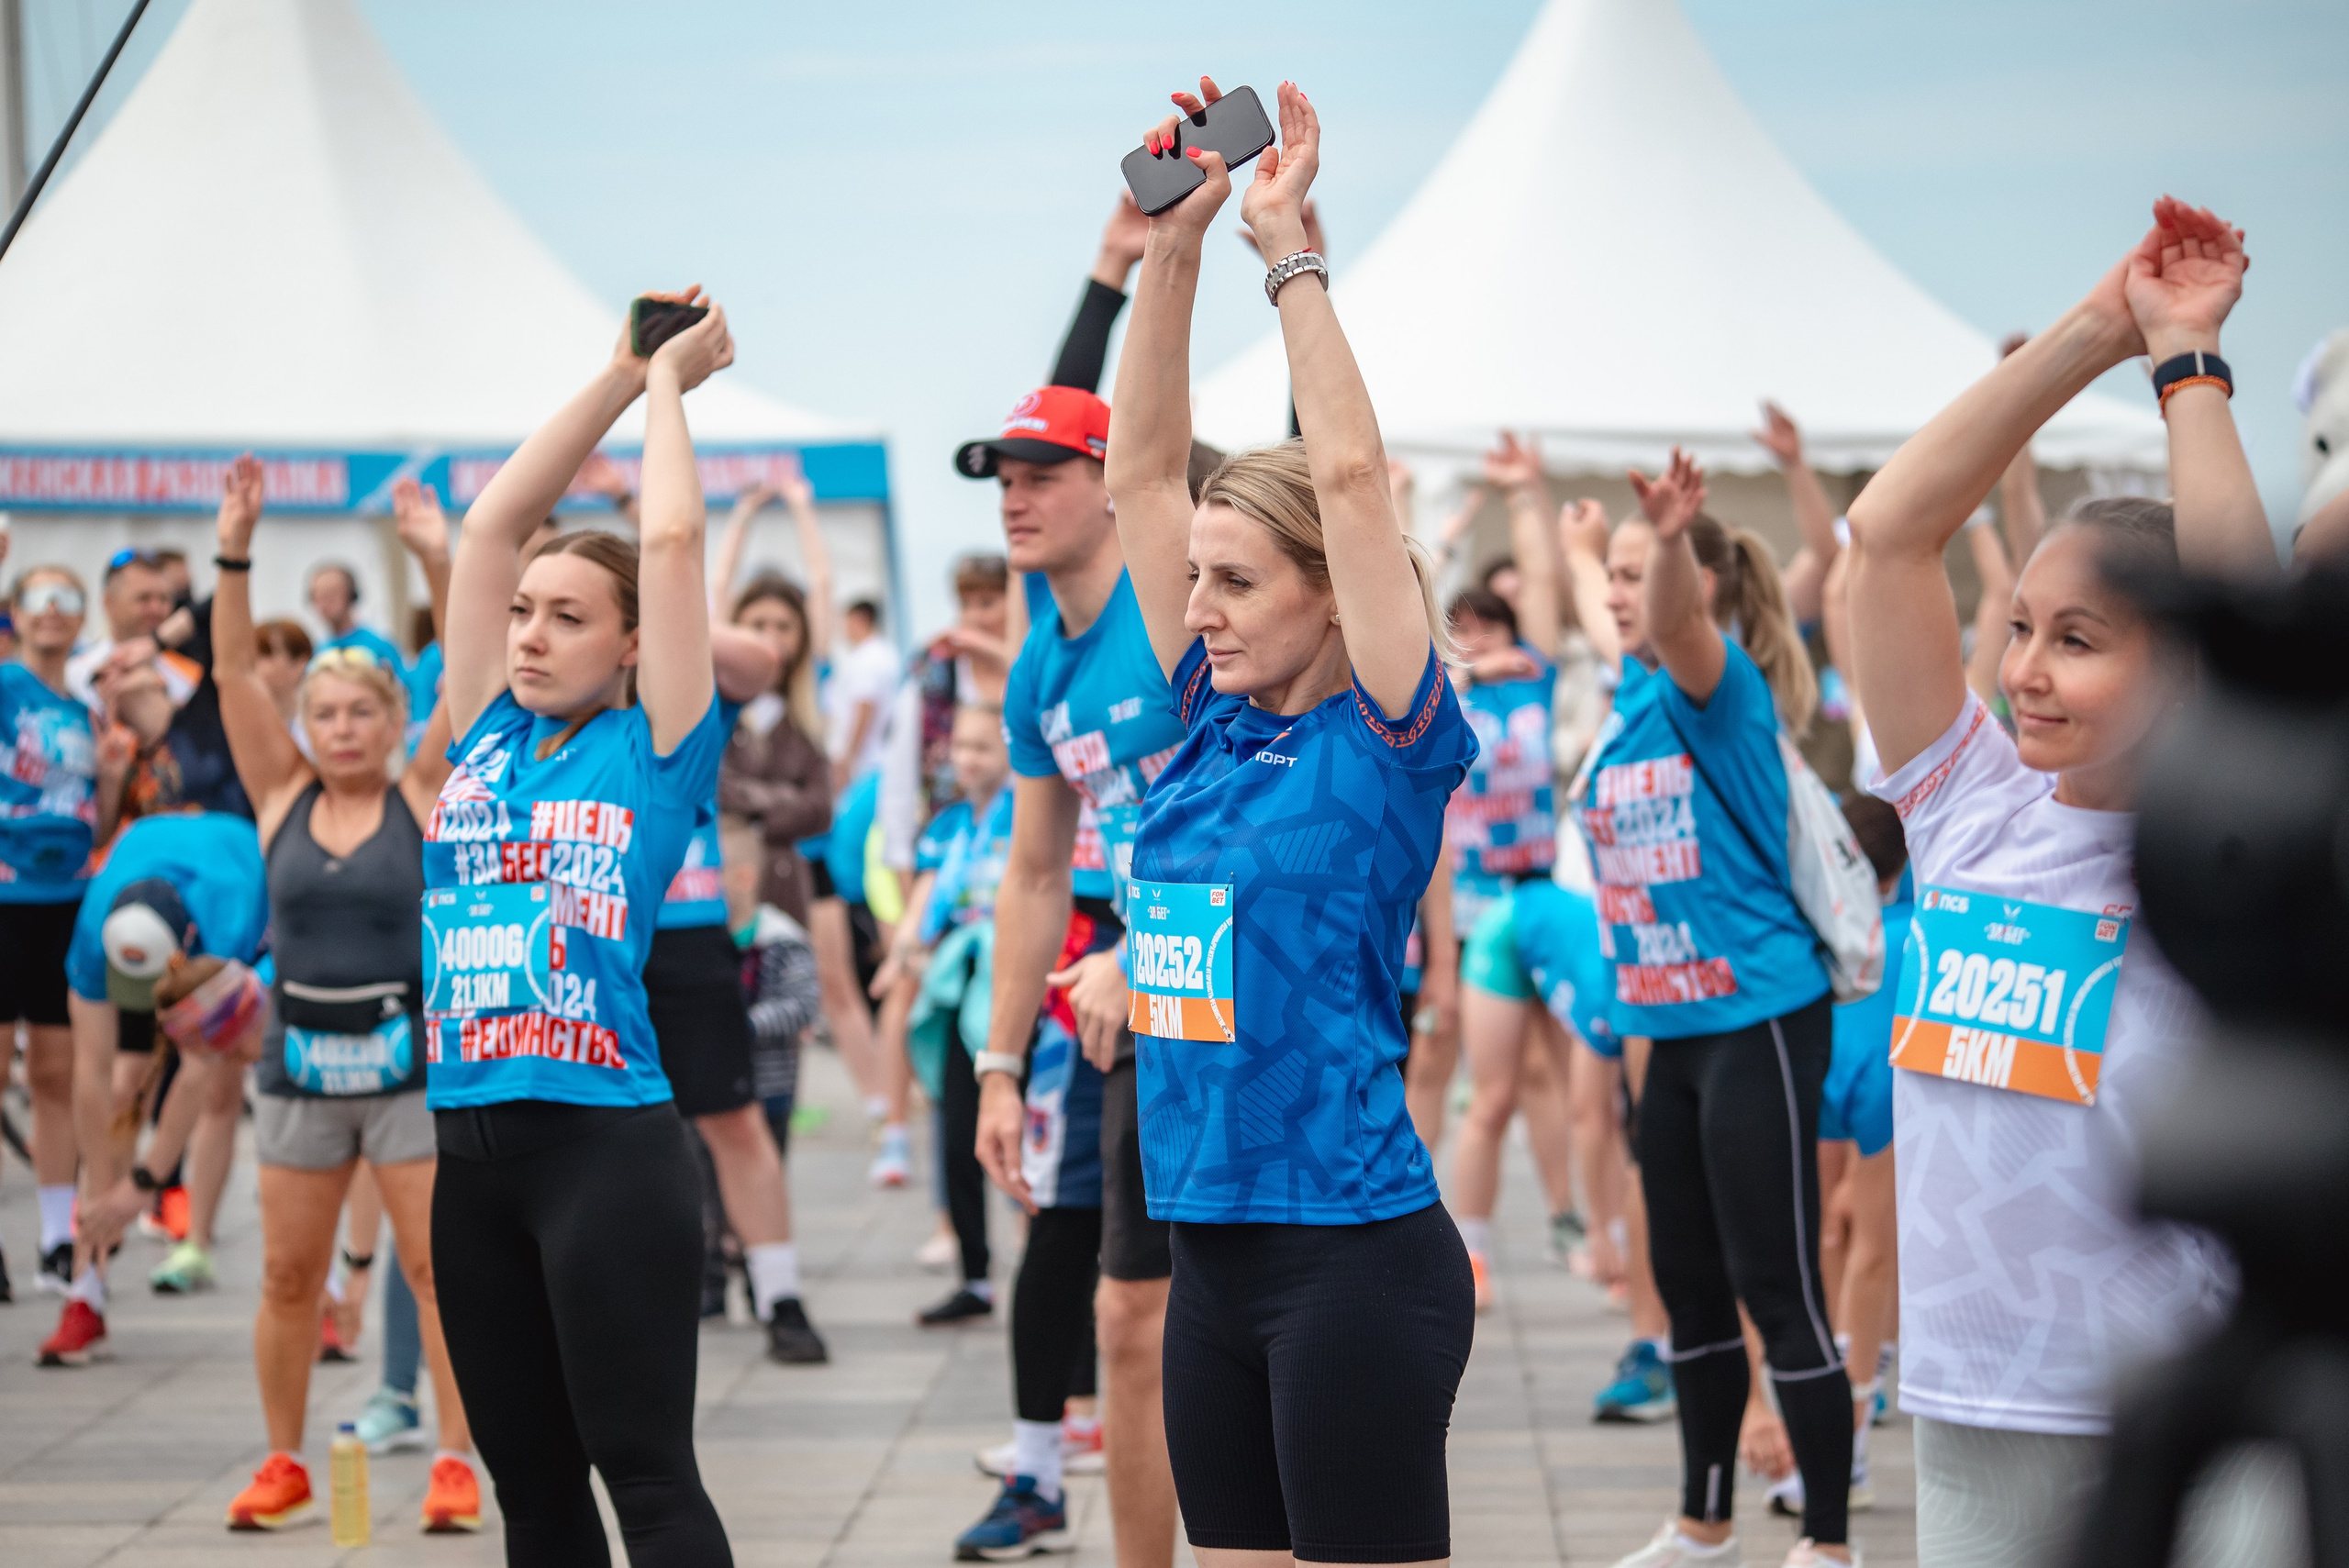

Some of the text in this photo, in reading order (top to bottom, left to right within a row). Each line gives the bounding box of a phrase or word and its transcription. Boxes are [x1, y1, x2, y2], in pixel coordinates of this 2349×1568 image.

[529, 799, 635, 854] #ЦЕЛЬ
[440, 923, 525, 972] 40006
[1135, 930, 1204, 990] 20252
[1149, 993, 1184, 1040] 5KM
[1928, 948, 2067, 1035] 20251
[1942, 1025, 2018, 1089] 5KM
